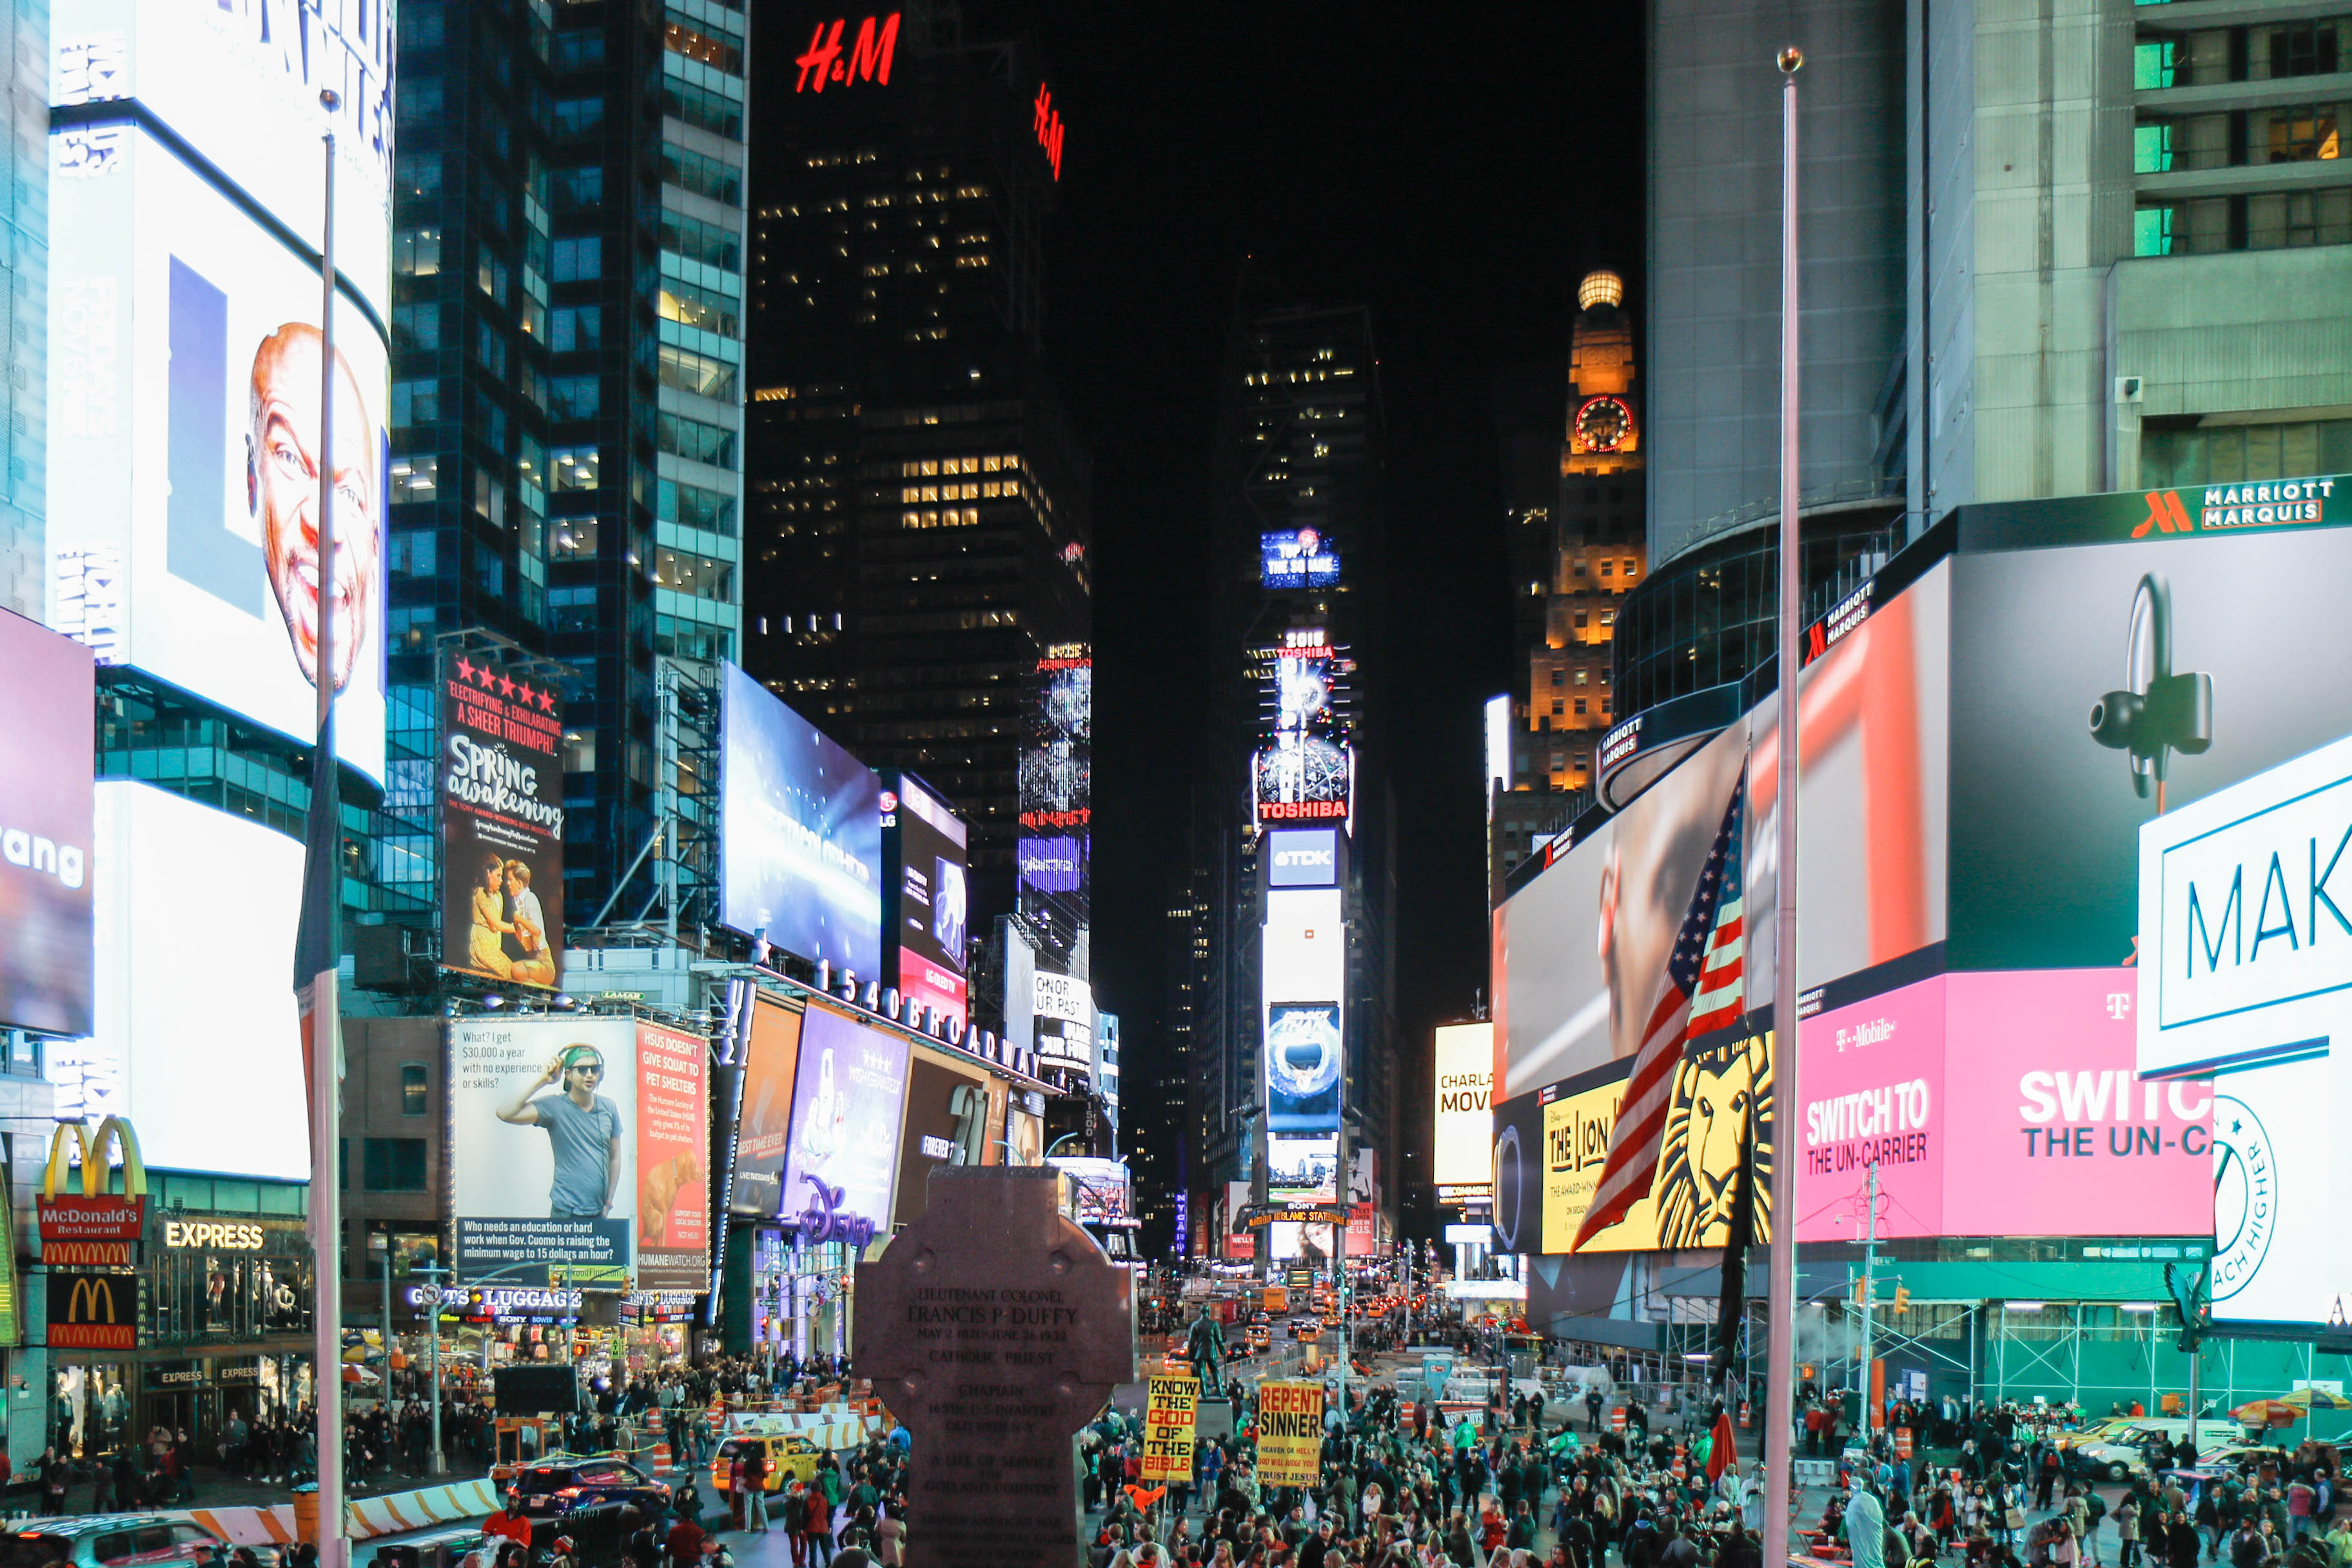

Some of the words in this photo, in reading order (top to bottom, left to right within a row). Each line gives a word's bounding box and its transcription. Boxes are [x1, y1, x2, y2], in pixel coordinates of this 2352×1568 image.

[795, 13, 900, 93] H&M
[1034, 83, 1064, 182] H&M
[2204, 482, 2334, 506] MARRIOTT
[2204, 504, 2318, 527] MARQUIS
[1827, 582, 1873, 627] MARRIOTT
[1827, 605, 1867, 645] MARQUIS
[1286, 631, 1324, 647] 2015
[1277, 647, 1333, 658] TOSHIBA
[458, 702, 465, 723] A
[467, 706, 500, 736] SHEER
[1602, 718, 1642, 751] MARRIOTT
[1602, 738, 1634, 769] MARQUIS
[452, 735, 537, 796] SPRING
[448, 774, 564, 839] awakening
[1259, 801, 1346, 819] TOSHIBA
[879, 815, 896, 827] LG
[0, 825, 84, 889] ang
[1289, 850, 1331, 865] TDK
[2187, 824, 2352, 979] MAK
[926, 968, 934, 983] LG
[935, 972, 948, 988] OLED
[948, 980, 956, 994] TV
[1036, 977, 1069, 995] ONOR
[605, 991, 642, 1001] LAMAR
[1037, 995, 1052, 1010] UR
[1058, 998, 1079, 1015] PAST
[2106, 994, 2130, 1019] T
[816, 959, 899, 1020] 1540
[906, 997, 1040, 1079] BROADWAY
[463, 1032, 490, 1042] What?
[496, 1032, 511, 1044] get
[645, 1032, 664, 1048] HSUS
[666, 1037, 698, 1057] DOESN'T
[463, 1047, 497, 1059] $30,000
[507, 1050, 525, 1060] year
[463, 1063, 481, 1073] with
[484, 1064, 493, 1073] no
[495, 1063, 542, 1075] experience
[643, 1051, 662, 1068] GIVE
[663, 1055, 687, 1074] SQUAT
[689, 1063, 699, 1077] TO
[463, 1080, 471, 1088] or
[473, 1078, 499, 1088] skills?
[647, 1072, 660, 1087] PET
[662, 1075, 696, 1095] SHELTERS
[1441, 1073, 1493, 1088] CHARLA
[2019, 1070, 2213, 1122] SWITC
[1806, 1086, 1892, 1146] SWITCH
[1894, 1078, 1927, 1130] TO
[738, 1139, 752, 1153] BEST
[752, 1135, 767, 1150] TIME
[768, 1133, 782, 1146] EVER
[923, 1135, 949, 1159] FOREVER
[1550, 1126, 1571, 1163] THE
[1575, 1110, 1608, 1172] LION
[2021, 1126, 2093, 1157] THE
[1808, 1149, 1832, 1175] THE
[1836, 1133, 1928, 1171] UN-CARRIER
[1551, 1186, 1561, 1198] THE
[1561, 1179, 1598, 1196] AWARD-WINN
[2247, 1140, 2268, 1251] HIGHER
[41, 1210, 137, 1223] McDonald's
[1309, 1211, 1326, 1221] STAT
[58, 1226, 121, 1234] Restaurant
[166, 1222, 264, 1250] EXPRESS
[464, 1221, 482, 1231] Who
[484, 1222, 508, 1231] needs
[510, 1223, 520, 1232] an
[522, 1222, 562, 1232] education
[564, 1224, 572, 1233] or
[574, 1222, 593, 1233] hard
[464, 1234, 484, 1245] work
[486, 1235, 507, 1245] when
[509, 1235, 526, 1246] Gov.
[528, 1235, 556, 1246] Cuomo
[558, 1235, 565, 1246] is
[566, 1235, 594, 1248] raising
[596, 1236, 610, 1246] the
[464, 1248, 501, 1257] minimum
[502, 1250, 524, 1260] wage
[526, 1250, 535, 1258] to
[537, 1248, 547, 1258] 15
[549, 1249, 576, 1259] dollars
[578, 1251, 589, 1259] an
[591, 1250, 614, 1260] hour?
[638, 1253, 705, 1266] HUMANEWATCH.ORG
[2213, 1250, 2248, 1288] ACH
[411, 1288, 470, 1306] GTS
[485, 1289, 582, 1308] LUGGAGE
[661, 1291, 696, 1305] LUGGAGE
[918, 1289, 995, 1302] LIEUTENANT
[1000, 1290, 1064, 1303] COLONEL
[495, 1306, 511, 1315] NY
[907, 1306, 986, 1324] FRANCIS
[1012, 1308, 1079, 1326] DUFFY
[917, 1329, 940, 1339] MAY
[162, 1371, 202, 1383] EXPRESS
[222, 1367, 258, 1378] EXPRESS
[1150, 1380, 1197, 1395] KNOW
[1154, 1396, 1191, 1409] THE
[1260, 1387, 1321, 1413] REPENT
[1148, 1410, 1194, 1426] GOD
[1260, 1412, 1318, 1438] SINNER
[1156, 1427, 1182, 1439] OF
[1147, 1441, 1190, 1456] THE
[1144, 1457, 1190, 1471] BIBLE
[1258, 1458, 1269, 1467] GOD
[1271, 1458, 1283, 1467] WILL
[1284, 1459, 1301, 1467] JUDGE
[1258, 1471, 1287, 1480] TRUST
[1289, 1473, 1318, 1482] JESUS
